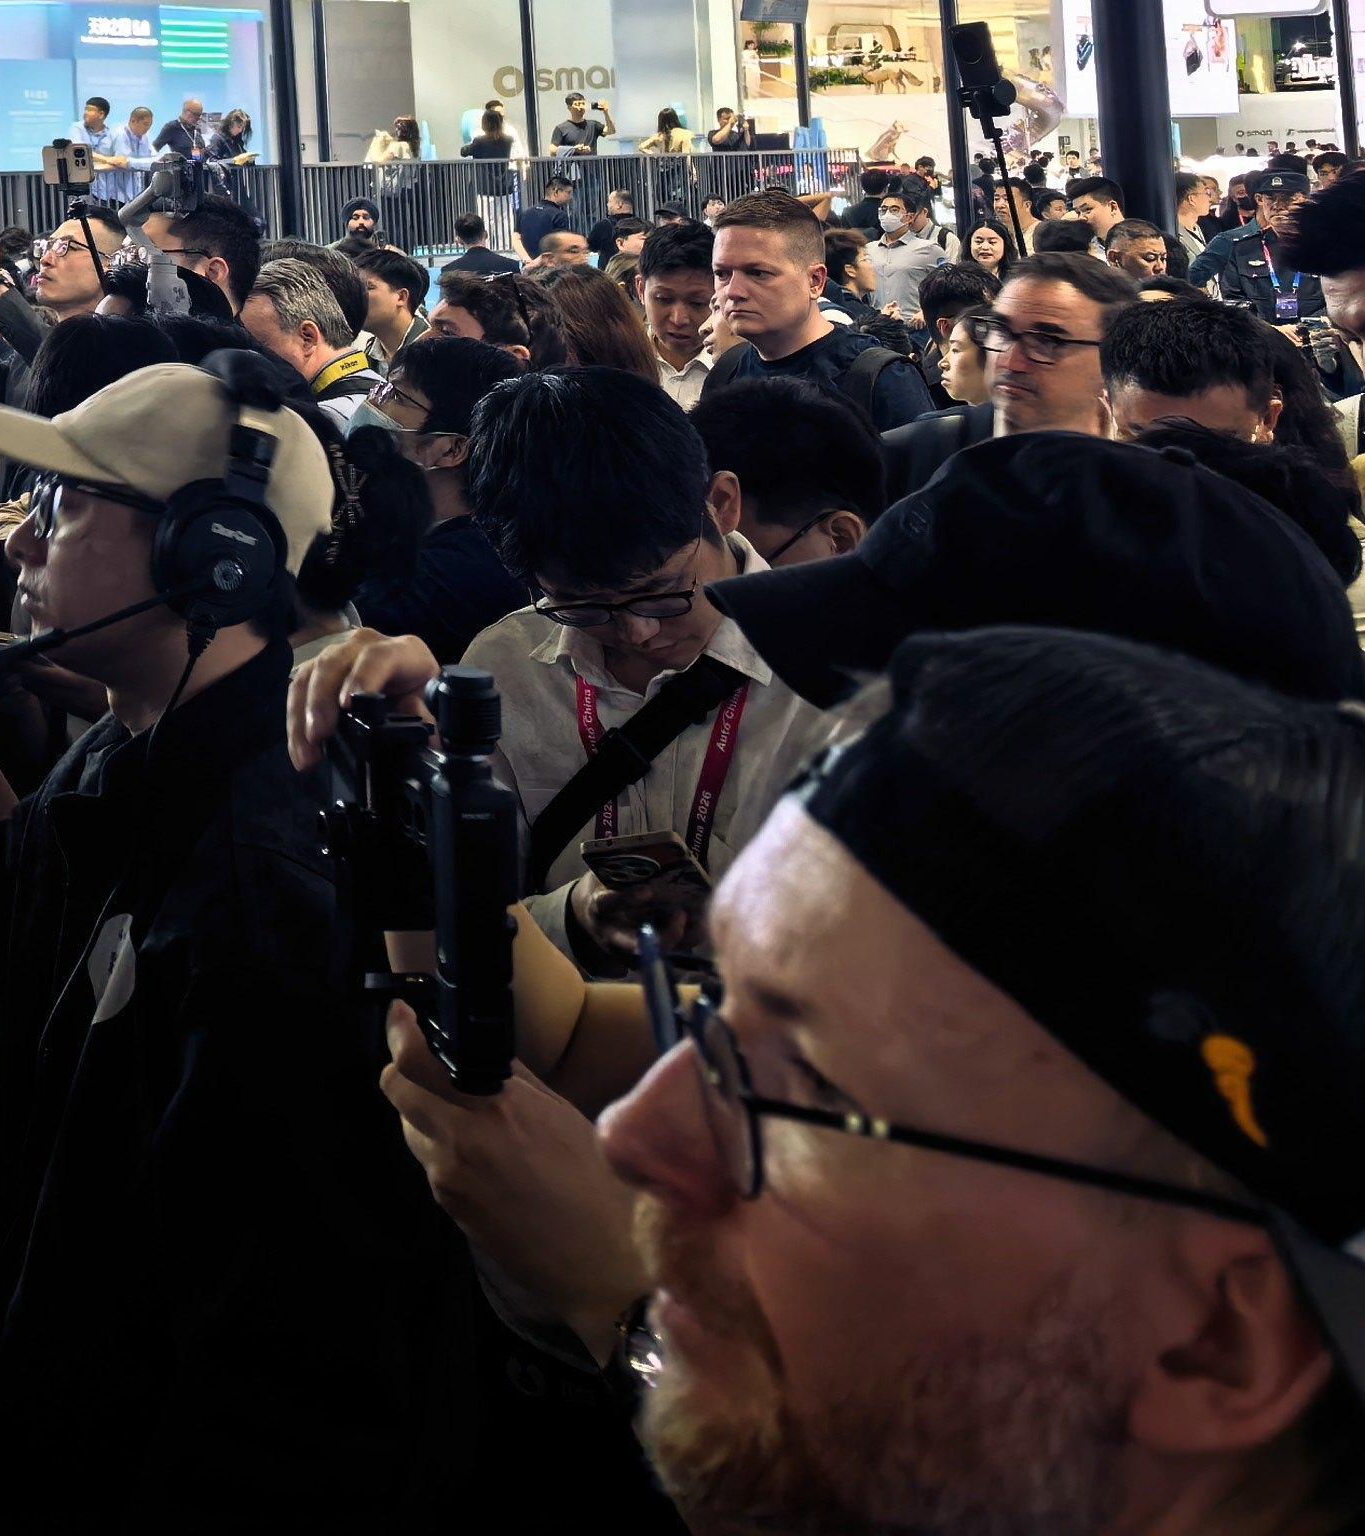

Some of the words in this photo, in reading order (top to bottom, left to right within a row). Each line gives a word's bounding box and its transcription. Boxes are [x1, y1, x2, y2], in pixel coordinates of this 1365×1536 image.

[582, 688, 593, 727] China
[716, 722, 732, 753] Auto
[696, 790, 713, 823] 2026
